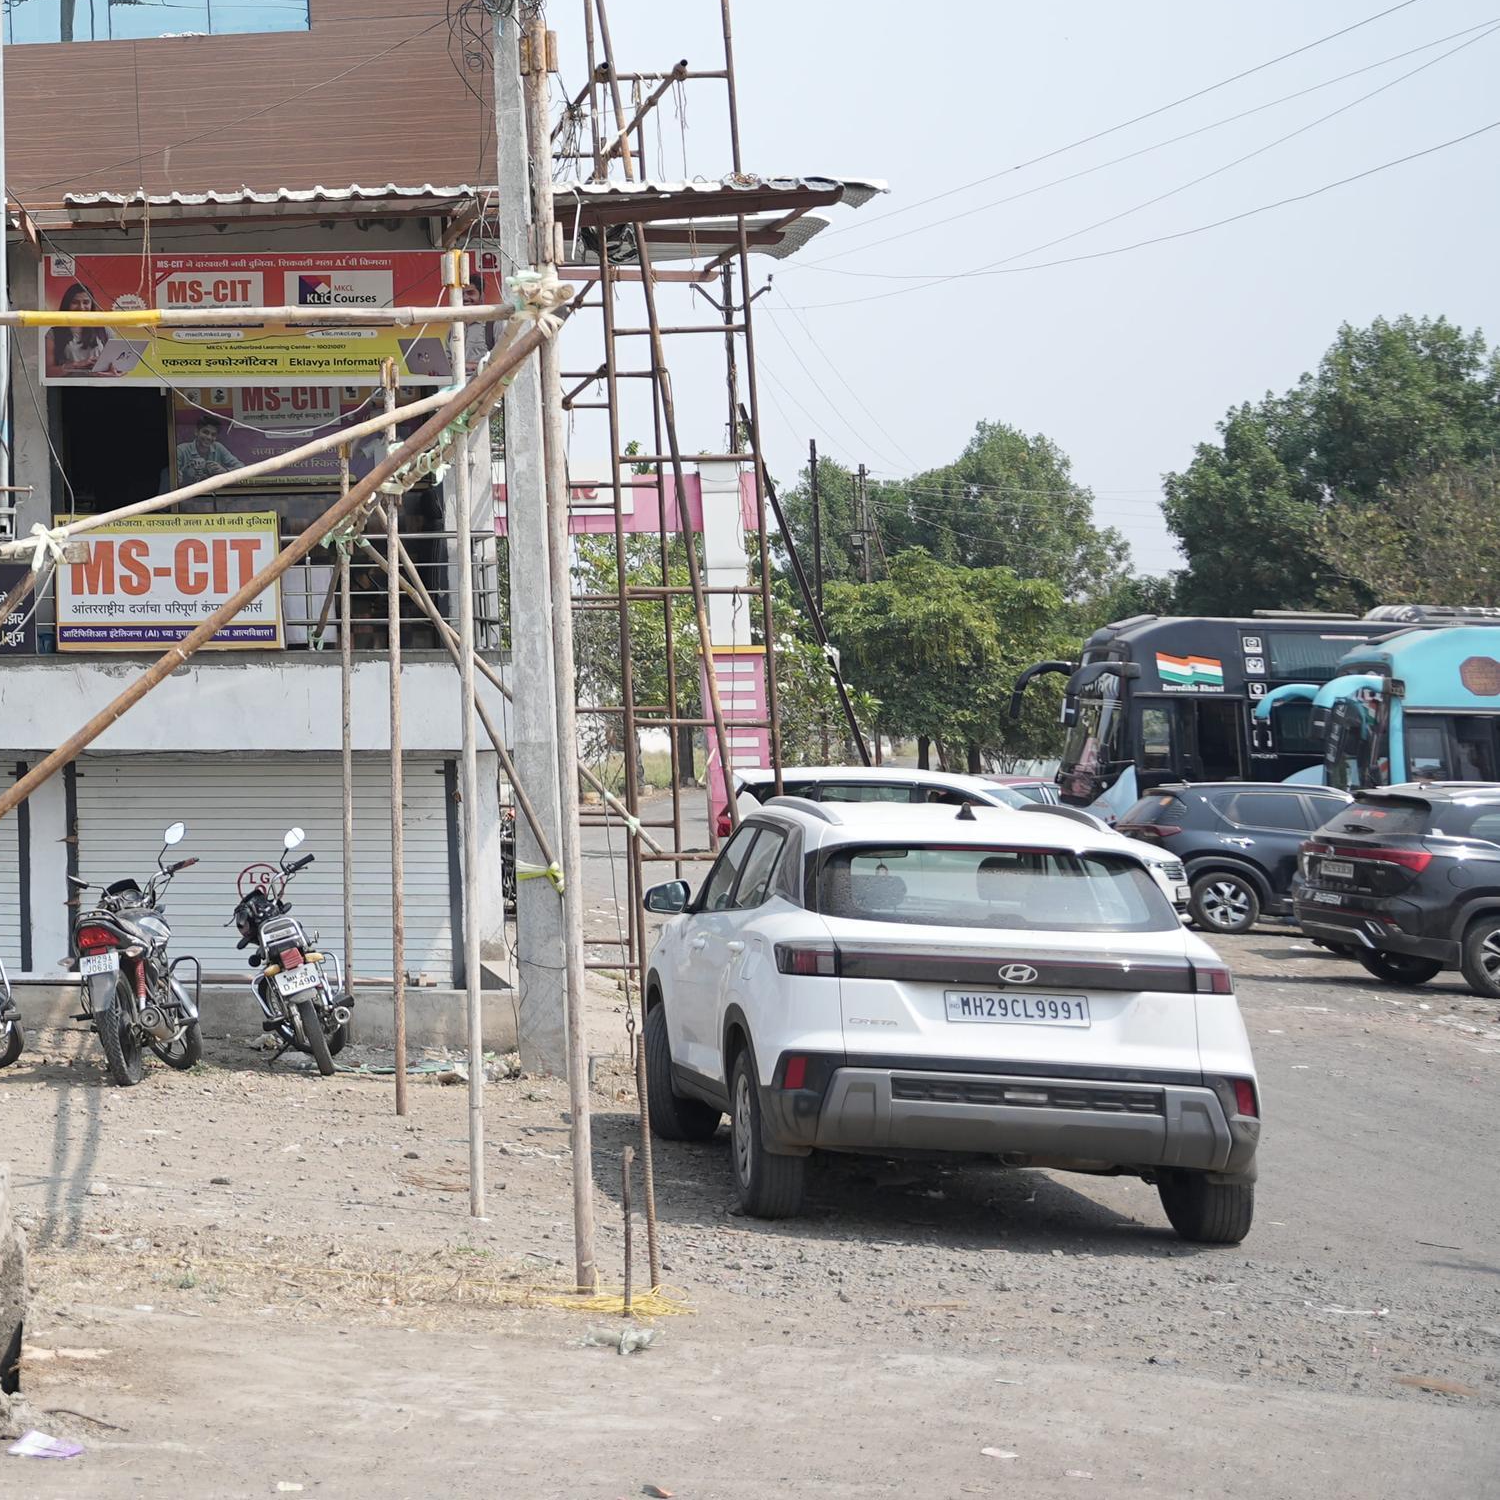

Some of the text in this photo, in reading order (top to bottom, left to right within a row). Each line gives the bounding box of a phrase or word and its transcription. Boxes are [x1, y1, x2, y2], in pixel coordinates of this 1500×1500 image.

[157, 260, 184, 268] MS-CIT
[167, 279, 252, 303] MS-CIT
[334, 293, 377, 303] Courses
[162, 358, 201, 368] एकलव्य
[289, 357, 331, 368] Eklavya
[241, 386, 332, 411] MS-CIT
[71, 538, 261, 596] MS-CIT
[72, 600, 197, 618] आंतरराष्ट्रीय दर्जाचा परिपूर्ण
[144, 629, 160, 638] (AI)
[1162, 684, 1225, 692] Incredible Bharat
[249, 872, 271, 884] LG
[282, 974, 317, 992] D.7490
[961, 996, 1085, 1020] MH29CL9991
[849, 1017, 899, 1026] CRETA
